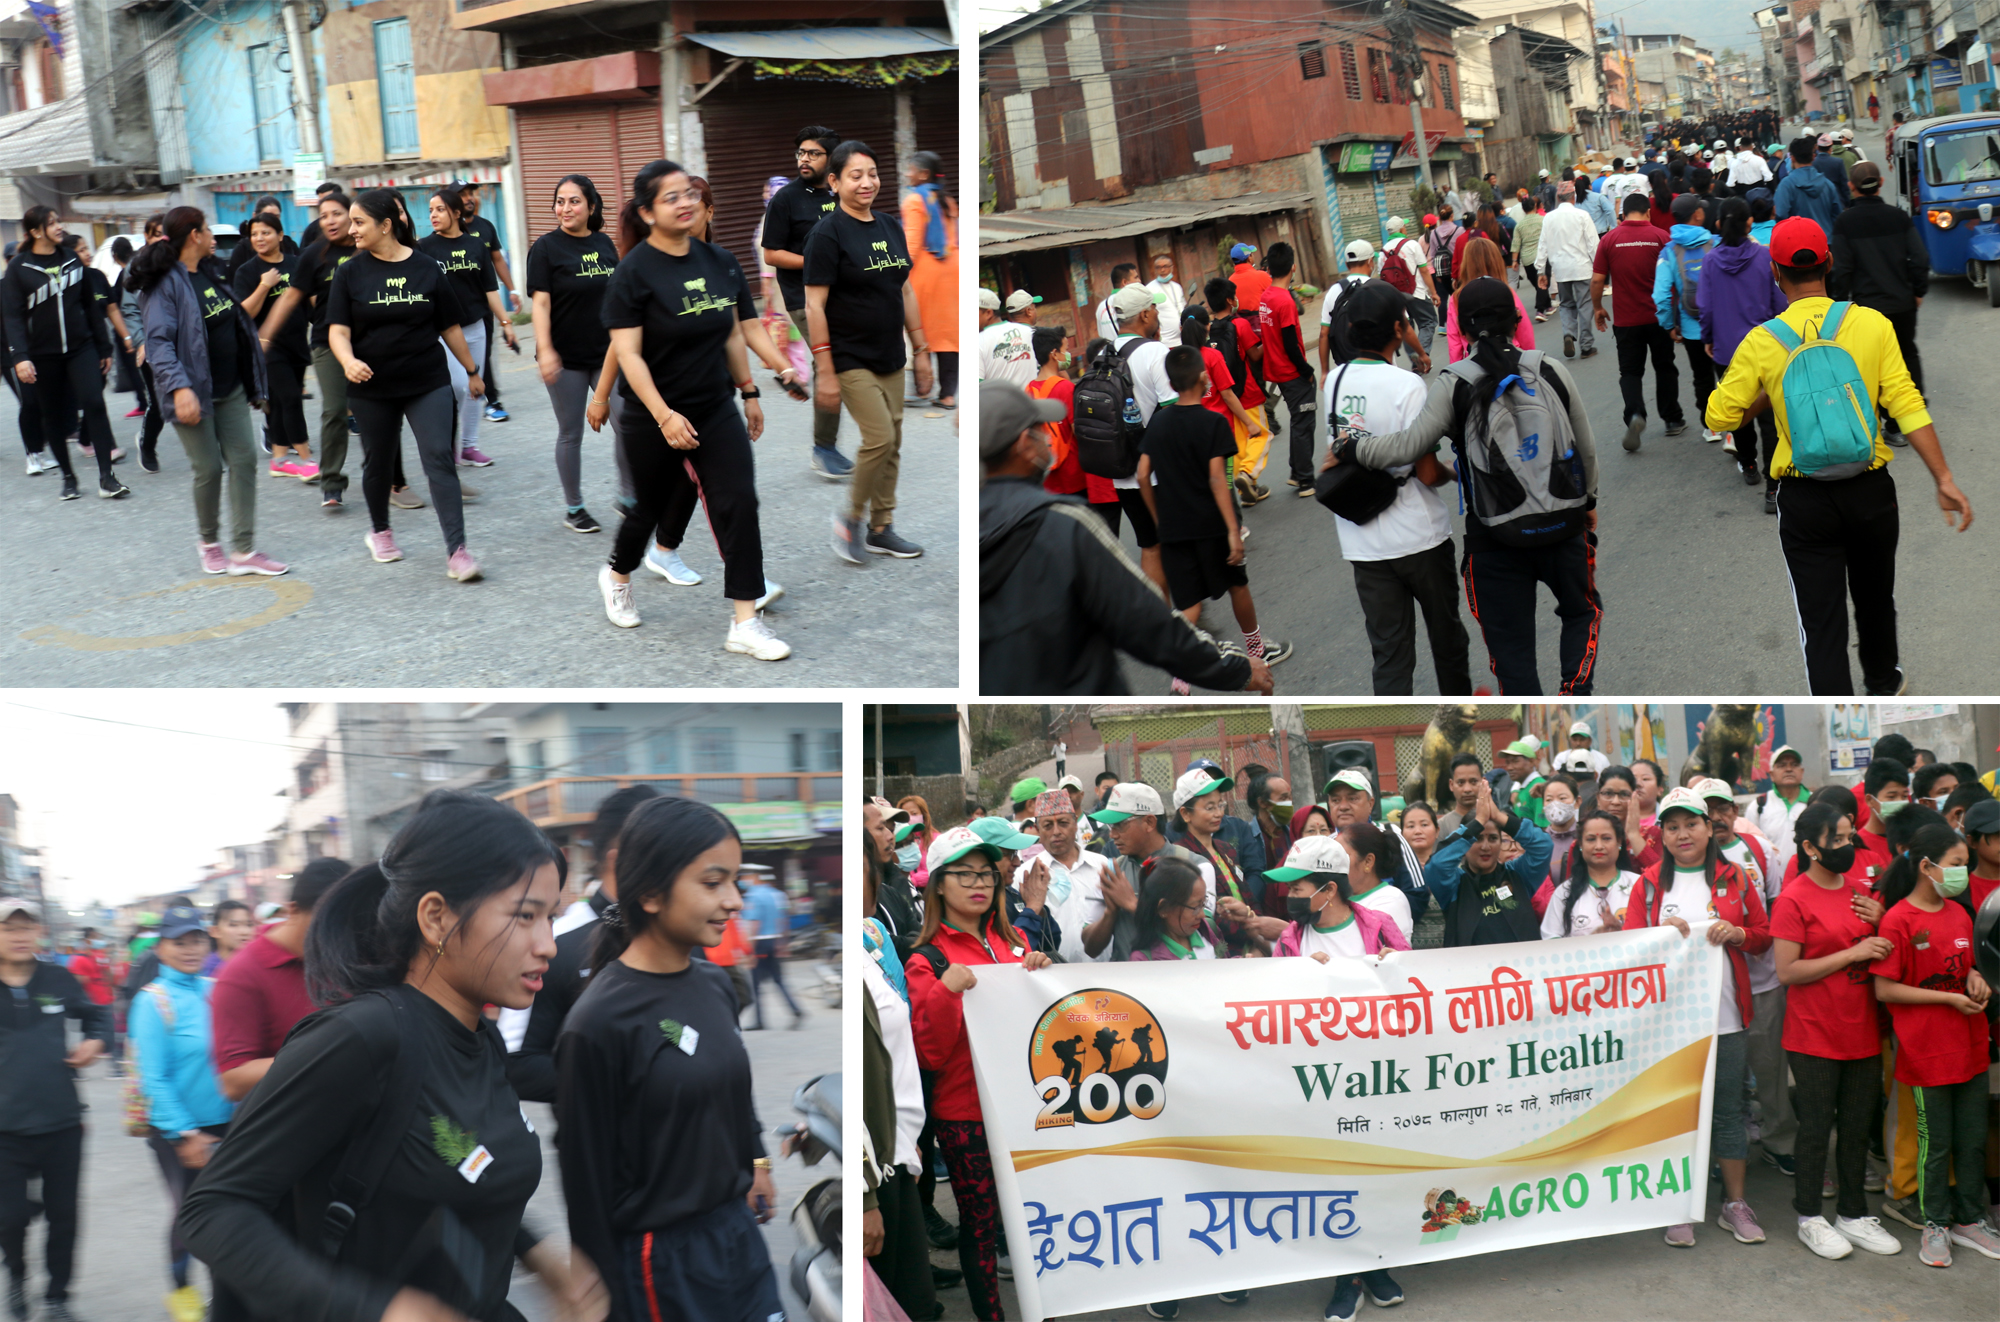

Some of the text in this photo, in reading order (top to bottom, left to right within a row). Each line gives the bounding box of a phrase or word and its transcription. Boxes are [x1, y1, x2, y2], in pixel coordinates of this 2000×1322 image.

[1094, 1012, 1130, 1022] अभियान
[1225, 963, 1666, 1050] स्वास्थ्यको लागि पदयात्रा
[1292, 1030, 1624, 1102] Walk For Health
[1033, 1072, 1166, 1131] 200
[1038, 1116, 1073, 1127] HIKING
[1337, 1115, 1371, 1134] मिति
[1393, 1115, 1432, 1131] २०७८
[1440, 1105, 1488, 1125] फाल्गुण
[1496, 1103, 1513, 1116] २८
[1550, 1088, 1593, 1106] शनिबार
[1481, 1155, 1691, 1223] AGRO TRAI
[1185, 1190, 1361, 1256] सप्ताह
